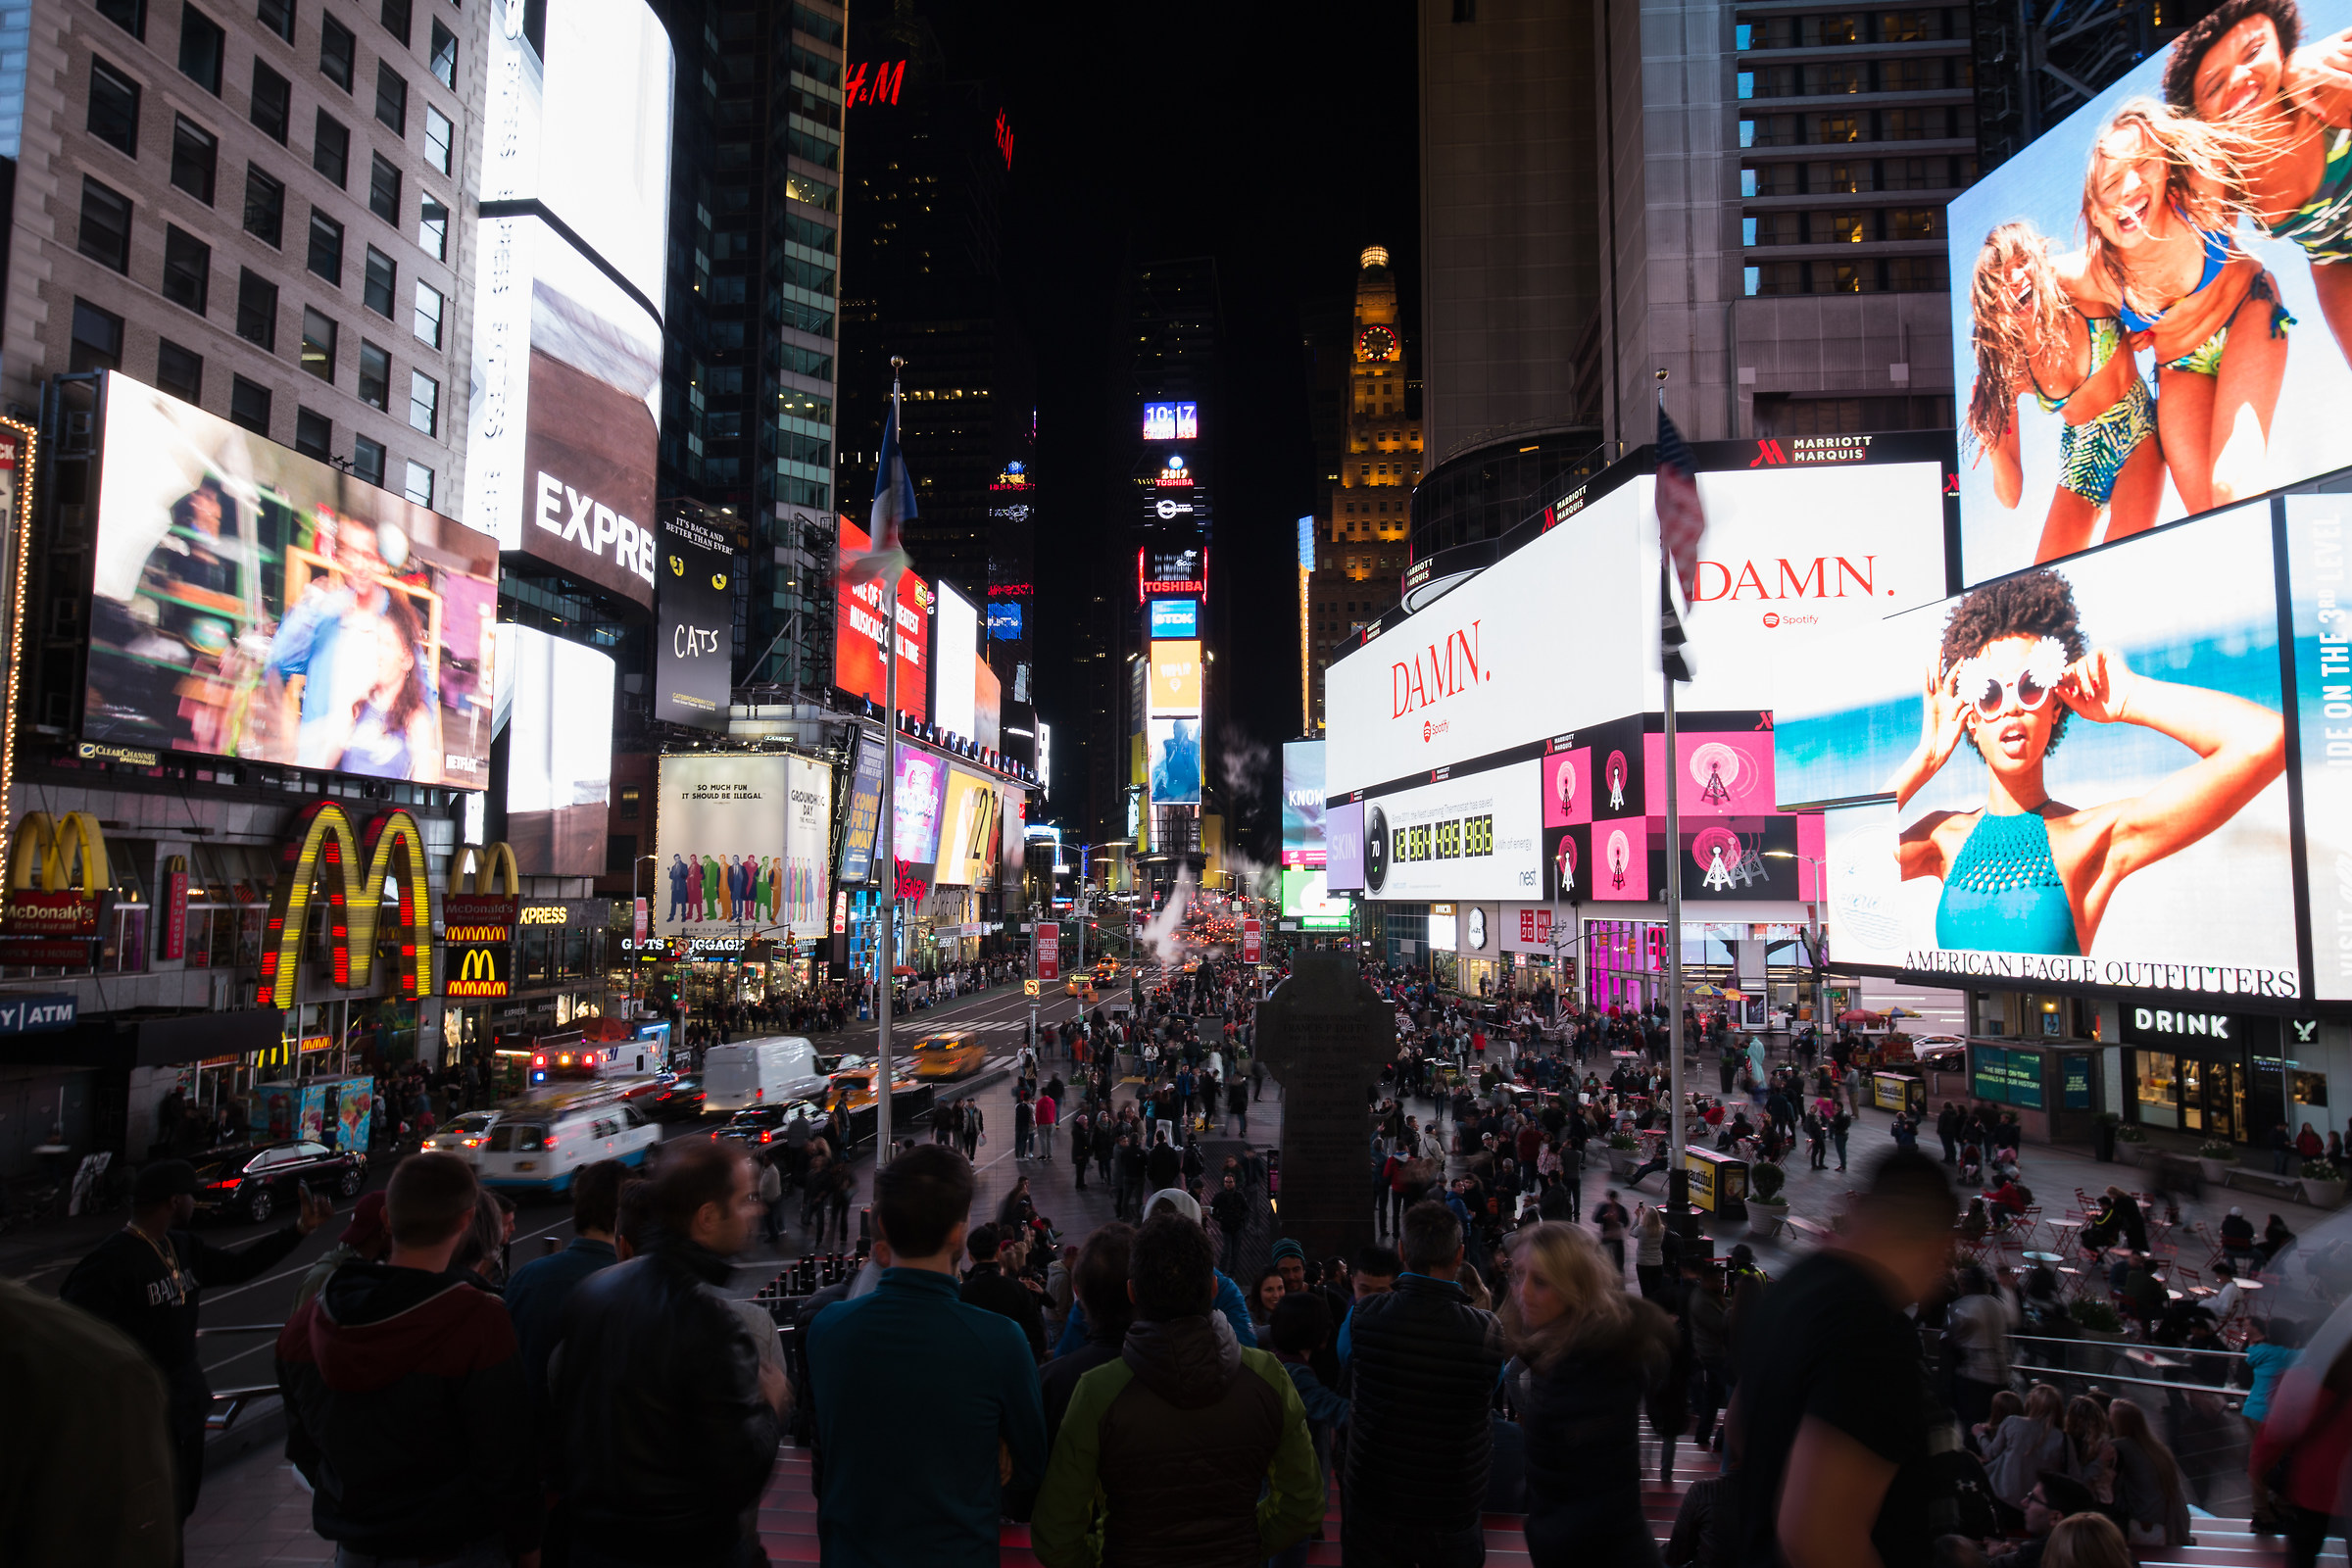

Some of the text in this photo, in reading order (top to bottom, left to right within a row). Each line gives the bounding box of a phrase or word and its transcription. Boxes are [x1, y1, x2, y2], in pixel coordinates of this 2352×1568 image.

[845, 59, 906, 109] H&M
[1147, 405, 1196, 422] 10:17
[1793, 435, 1873, 449] MARRIOTT
[1794, 448, 1864, 462] MARQUIS
[1155, 478, 1195, 487] TOSHIBA
[1161, 468, 1188, 479] 2017
[1556, 484, 1587, 511] MARRIOTT
[1556, 498, 1584, 521] MARQUIS
[536, 470, 656, 590] EXPRE
[676, 516, 724, 543] IT'S BACK AND
[693, 533, 712, 548] THAN
[2313, 513, 2343, 582] LEVEL
[1145, 580, 1203, 593] TOSHIBA
[1691, 554, 1896, 602] DAMN.
[850, 604, 884, 644] MUSICALS
[1163, 612, 1194, 624] TDK
[1782, 612, 1819, 628] Spotify
[673, 624, 719, 659] CATS
[905, 638, 919, 665] TIME
[2320, 631, 2349, 678] THE
[1392, 619, 1492, 720] DAMN.
[2324, 684, 2352, 719] ON
[1432, 718, 1450, 737] Spotify
[445, 754, 478, 773] NETFLIX
[950, 730, 1026, 780] BROADWAY
[854, 791, 879, 813] COME
[1289, 789, 1324, 807] KNOW
[803, 804, 814, 817] DAY
[850, 809, 877, 832] FROM
[847, 828, 874, 850] AWAY
[1332, 831, 1356, 861] SKIN
[1371, 840, 1381, 858] 70
[1518, 867, 1537, 887] nest
[446, 904, 514, 914] McDonald's
[519, 906, 567, 925] XPRESS
[688, 939, 746, 951] UGGAGE
[1902, 950, 2296, 999] AMERICAN EAGLE OUTFITTERS
[27, 1004, 74, 1024] ATM
[504, 1006, 528, 1017] EXPRESS
[2134, 1007, 2230, 1040] DRINK
[1876, 1082, 1904, 1099] Beautiful
[2018, 1079, 2041, 1090] HISTORY
